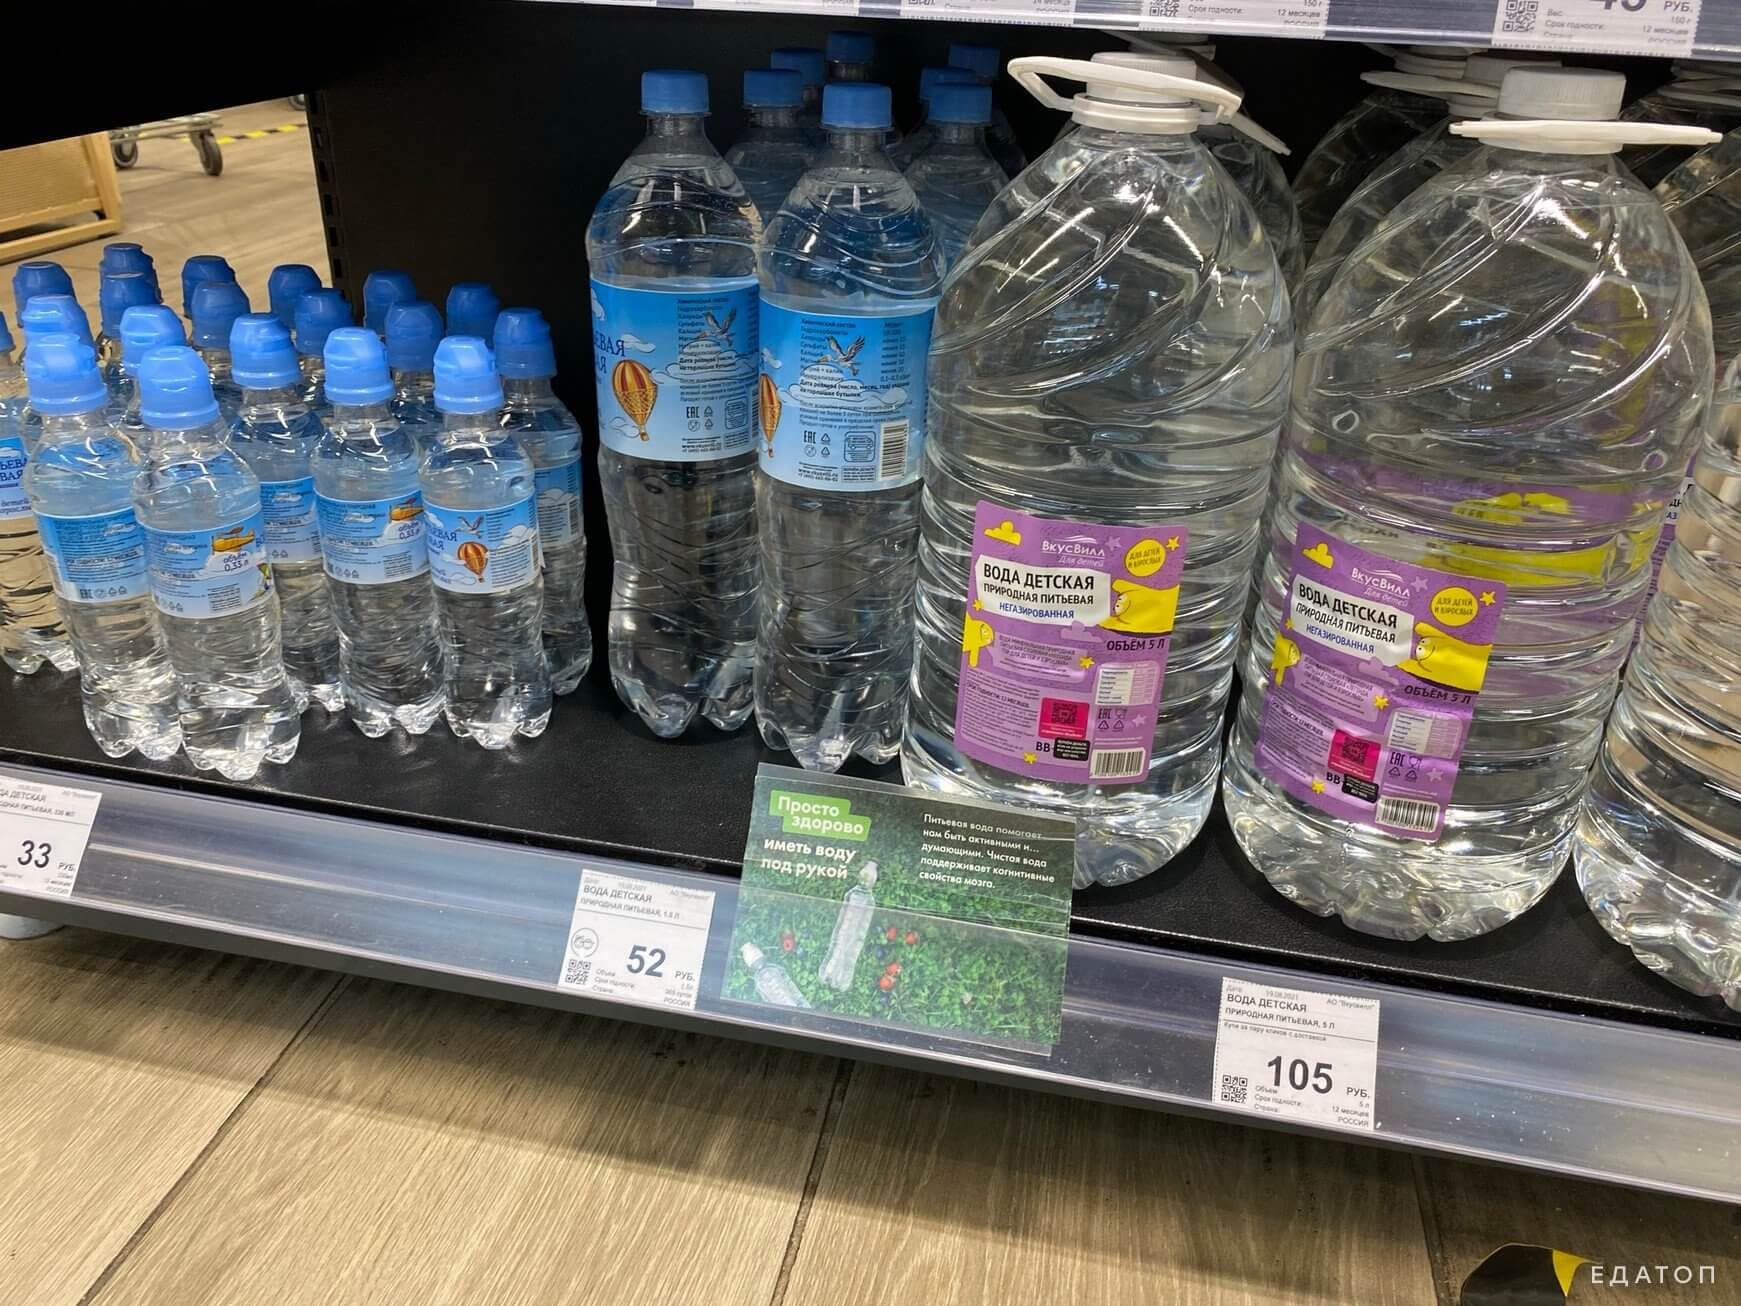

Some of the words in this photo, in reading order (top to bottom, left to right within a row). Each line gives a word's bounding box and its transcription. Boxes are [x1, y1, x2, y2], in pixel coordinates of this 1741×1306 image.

[1042, 540, 1105, 557] ВкусВилл
[984, 563, 1020, 585] ВОДА
[1024, 573, 1095, 591] ДЕТСКАЯ
[1351, 567, 1410, 597] ВкусВилл
[983, 582, 1038, 604] ПРИРОДНАЯ
[1040, 594, 1094, 605] ПИТЬЕВАЯ
[999, 601, 1075, 619] НЕГАЗИРОВАННАЯ
[1299, 583, 1330, 609] ВОДА
[1333, 598, 1398, 629] ДЕТСКАЯ
[1295, 602, 1344, 629] ПРИРОДНАЯ
[1345, 621, 1396, 644] ПИТЬЕВАЯ
[1106, 638, 1146, 652] ОБЪЁМ
[1149, 640, 1155, 650] 5
[1157, 638, 1166, 649] Л
[1305, 623, 1375, 654] НЕГАЗИРОВАННАЯ
[1403, 684, 1448, 701] ОБЪЁМ
[1452, 693, 1459, 702] 5
[1462, 694, 1472, 704] Л
[777, 795, 840, 817] Просто
[791, 815, 864, 835] здорово
[923, 813, 968, 829] Питьевая
[970, 823, 994, 834] вода
[995, 826, 1043, 840] помогает
[922, 829, 942, 838] нам
[943, 830, 967, 842] быть
[968, 835, 1021, 850] активными
[17, 839, 52, 869] 33
[763, 839, 812, 855] иметь
[815, 845, 857, 864] воду
[921, 843, 984, 859] думающими.
[986, 849, 1021, 864] Чистая
[1022, 857, 1047, 868] вода
[761, 858, 793, 875] под
[795, 862, 848, 880] рукой
[920, 857, 991, 874] поддерживает
[992, 866, 1056, 884] когнитивные
[919, 871, 963, 884] свойства
[963, 878, 996, 890] мозга.
[583, 884, 609, 897] ВОДА
[610, 889, 653, 904] ДЕТСКАЯ
[626, 944, 667, 978] 52
[674, 970, 696, 982] РУБ.
[1226, 993, 1257, 1006] ВОДА
[1258, 998, 1307, 1013] ДЕТСКАЯ
[1225, 1007, 1274, 1021] ПРИРОДНАЯ
[1275, 1015, 1321, 1029] ПИТЬЕВАЯ,
[1266, 1054, 1334, 1095] 105
[1345, 1086, 1371, 1099] РУБ.
[1338, 1116, 1369, 1127] РОССИЯ
